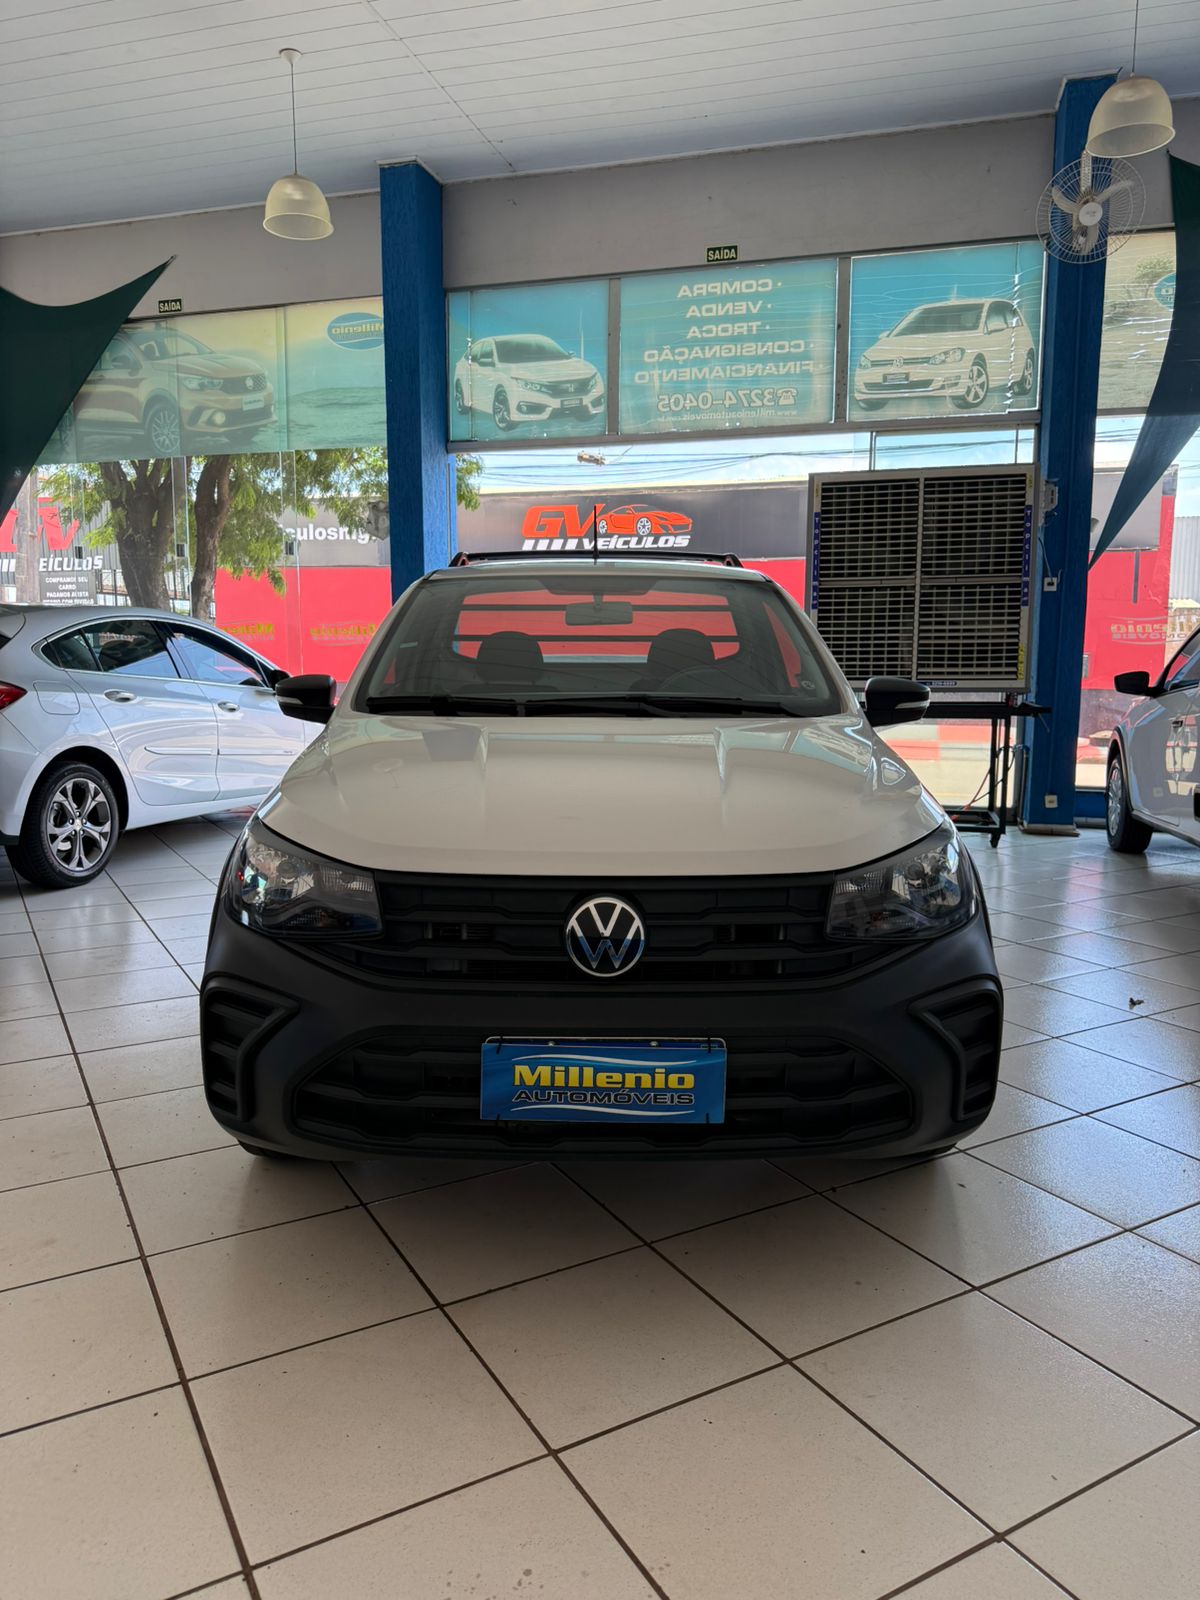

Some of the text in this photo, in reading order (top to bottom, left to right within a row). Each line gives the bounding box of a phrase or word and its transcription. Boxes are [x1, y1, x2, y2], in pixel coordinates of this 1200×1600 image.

[708, 248, 737, 261] SAÍDA
[159, 300, 181, 312] SAÍDA
[522, 503, 605, 538] GV
[582, 535, 691, 549] VEÍCULOS
[39, 555, 103, 572] EÍCULOS
[514, 1065, 695, 1089] Millenio
[512, 1088, 695, 1105] AUTOMÓVEIS
